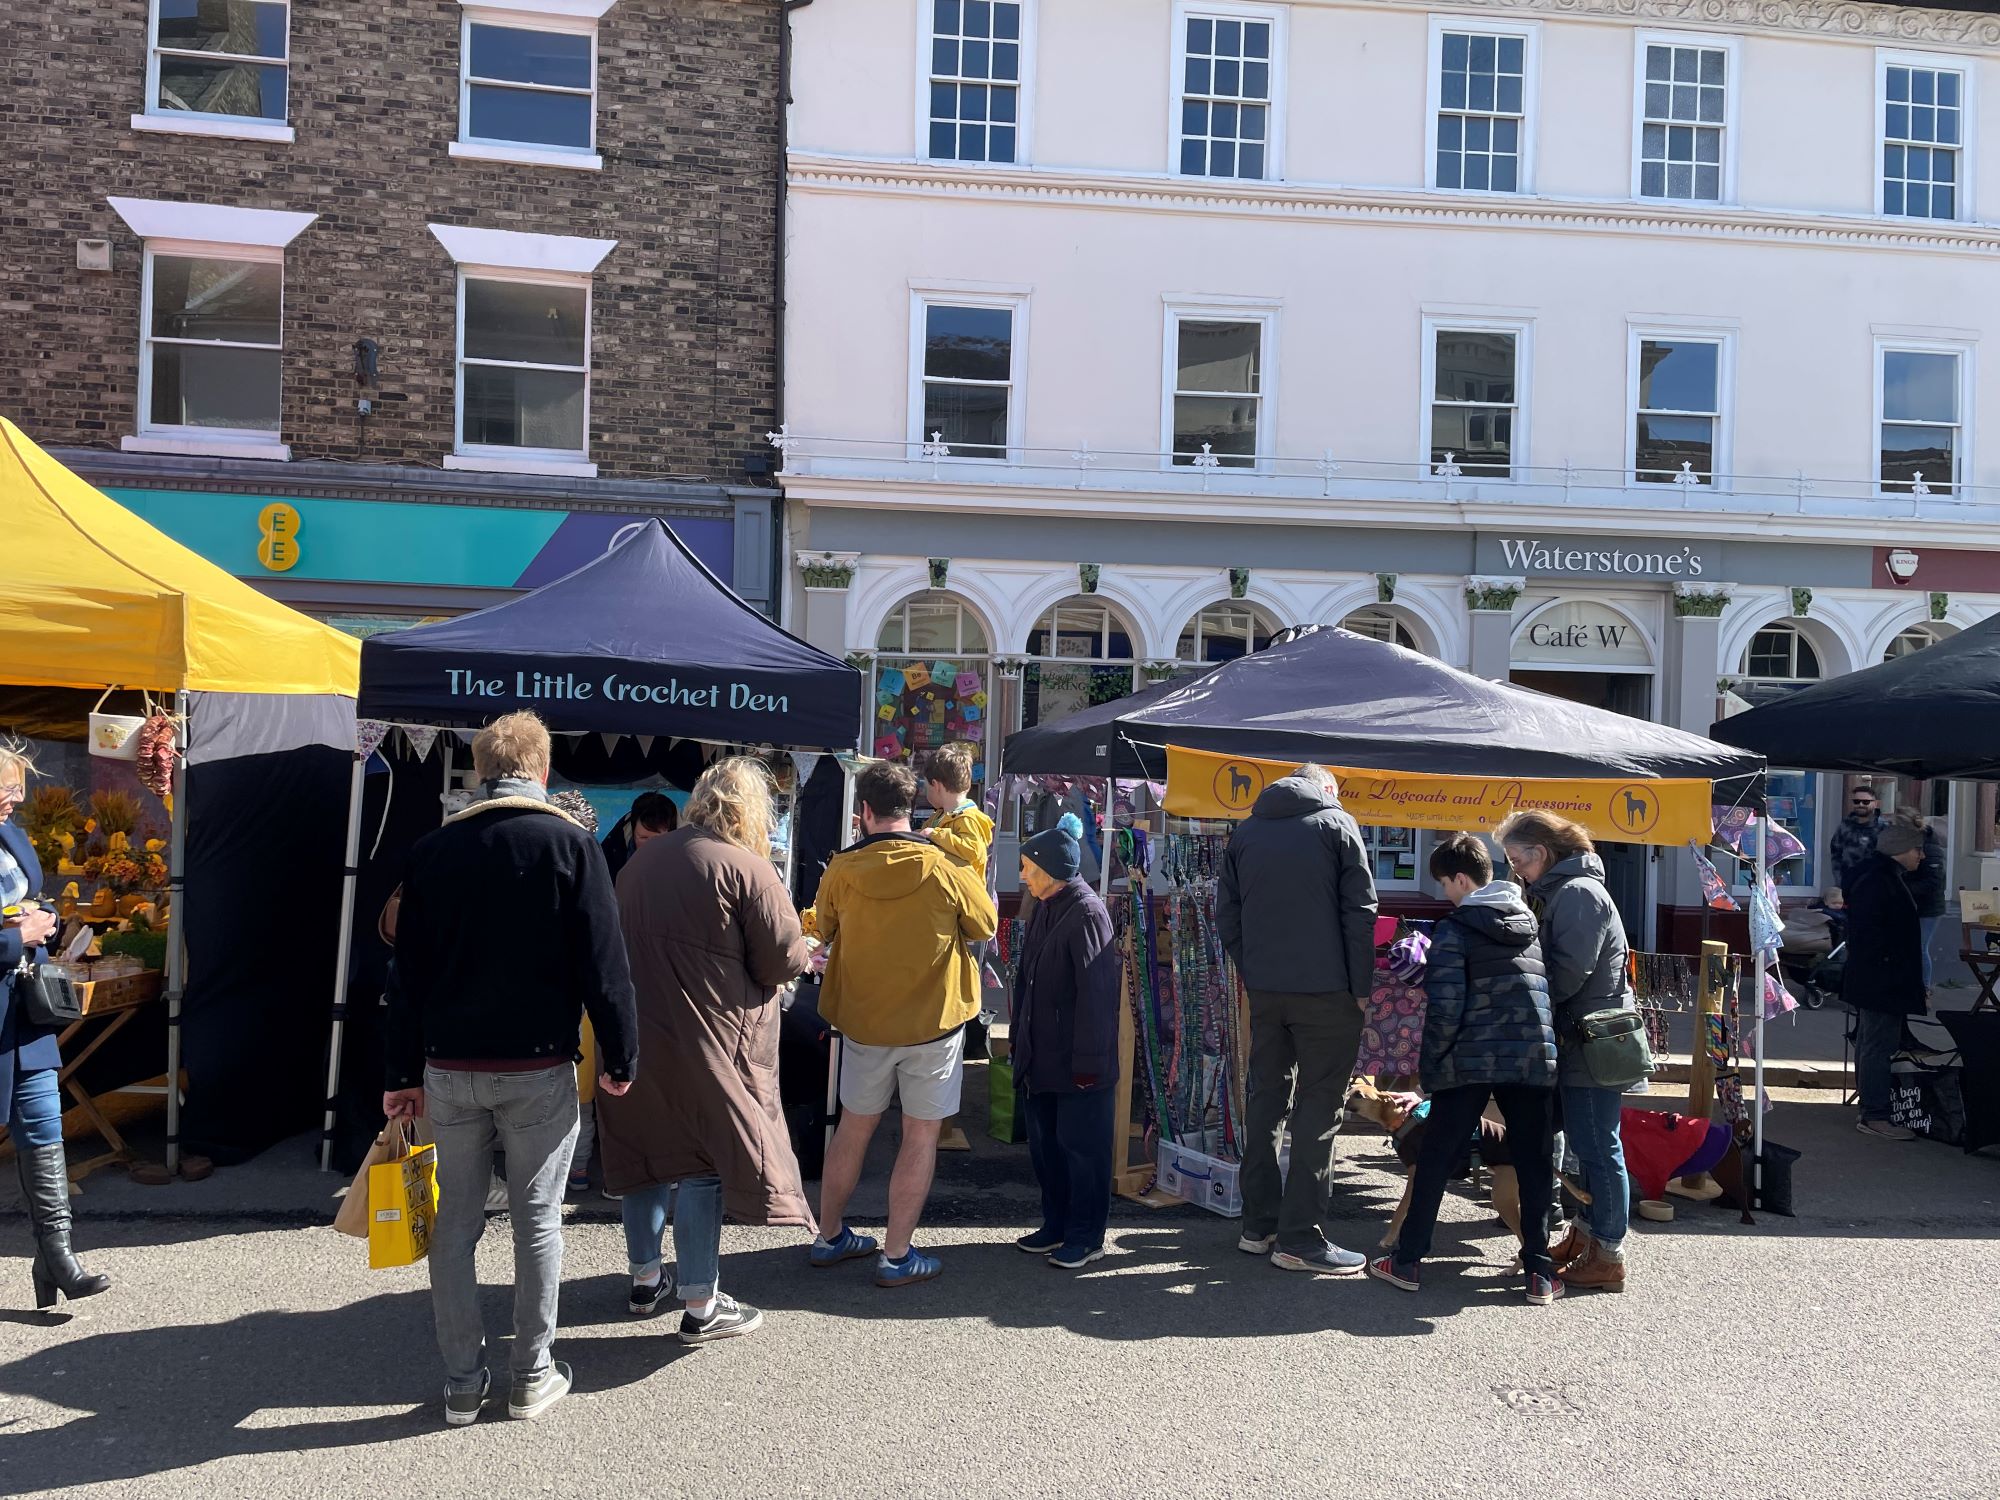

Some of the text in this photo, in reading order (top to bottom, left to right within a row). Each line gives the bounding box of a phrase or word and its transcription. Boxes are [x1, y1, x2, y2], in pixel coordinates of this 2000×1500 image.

[1499, 539, 1702, 576] Waterstone's
[1529, 623, 1627, 648] Café W
[445, 669, 788, 713] The Little Crochet Den
[1367, 778, 1448, 805] Dogcoats
[1452, 783, 1489, 806] and
[1491, 780, 1592, 812] Accessories
[1891, 1097, 1916, 1112] that
[1900, 1086, 1921, 1103] bag
[1903, 1113, 1932, 1134] iving!
[1908, 1108, 1924, 1119] on
